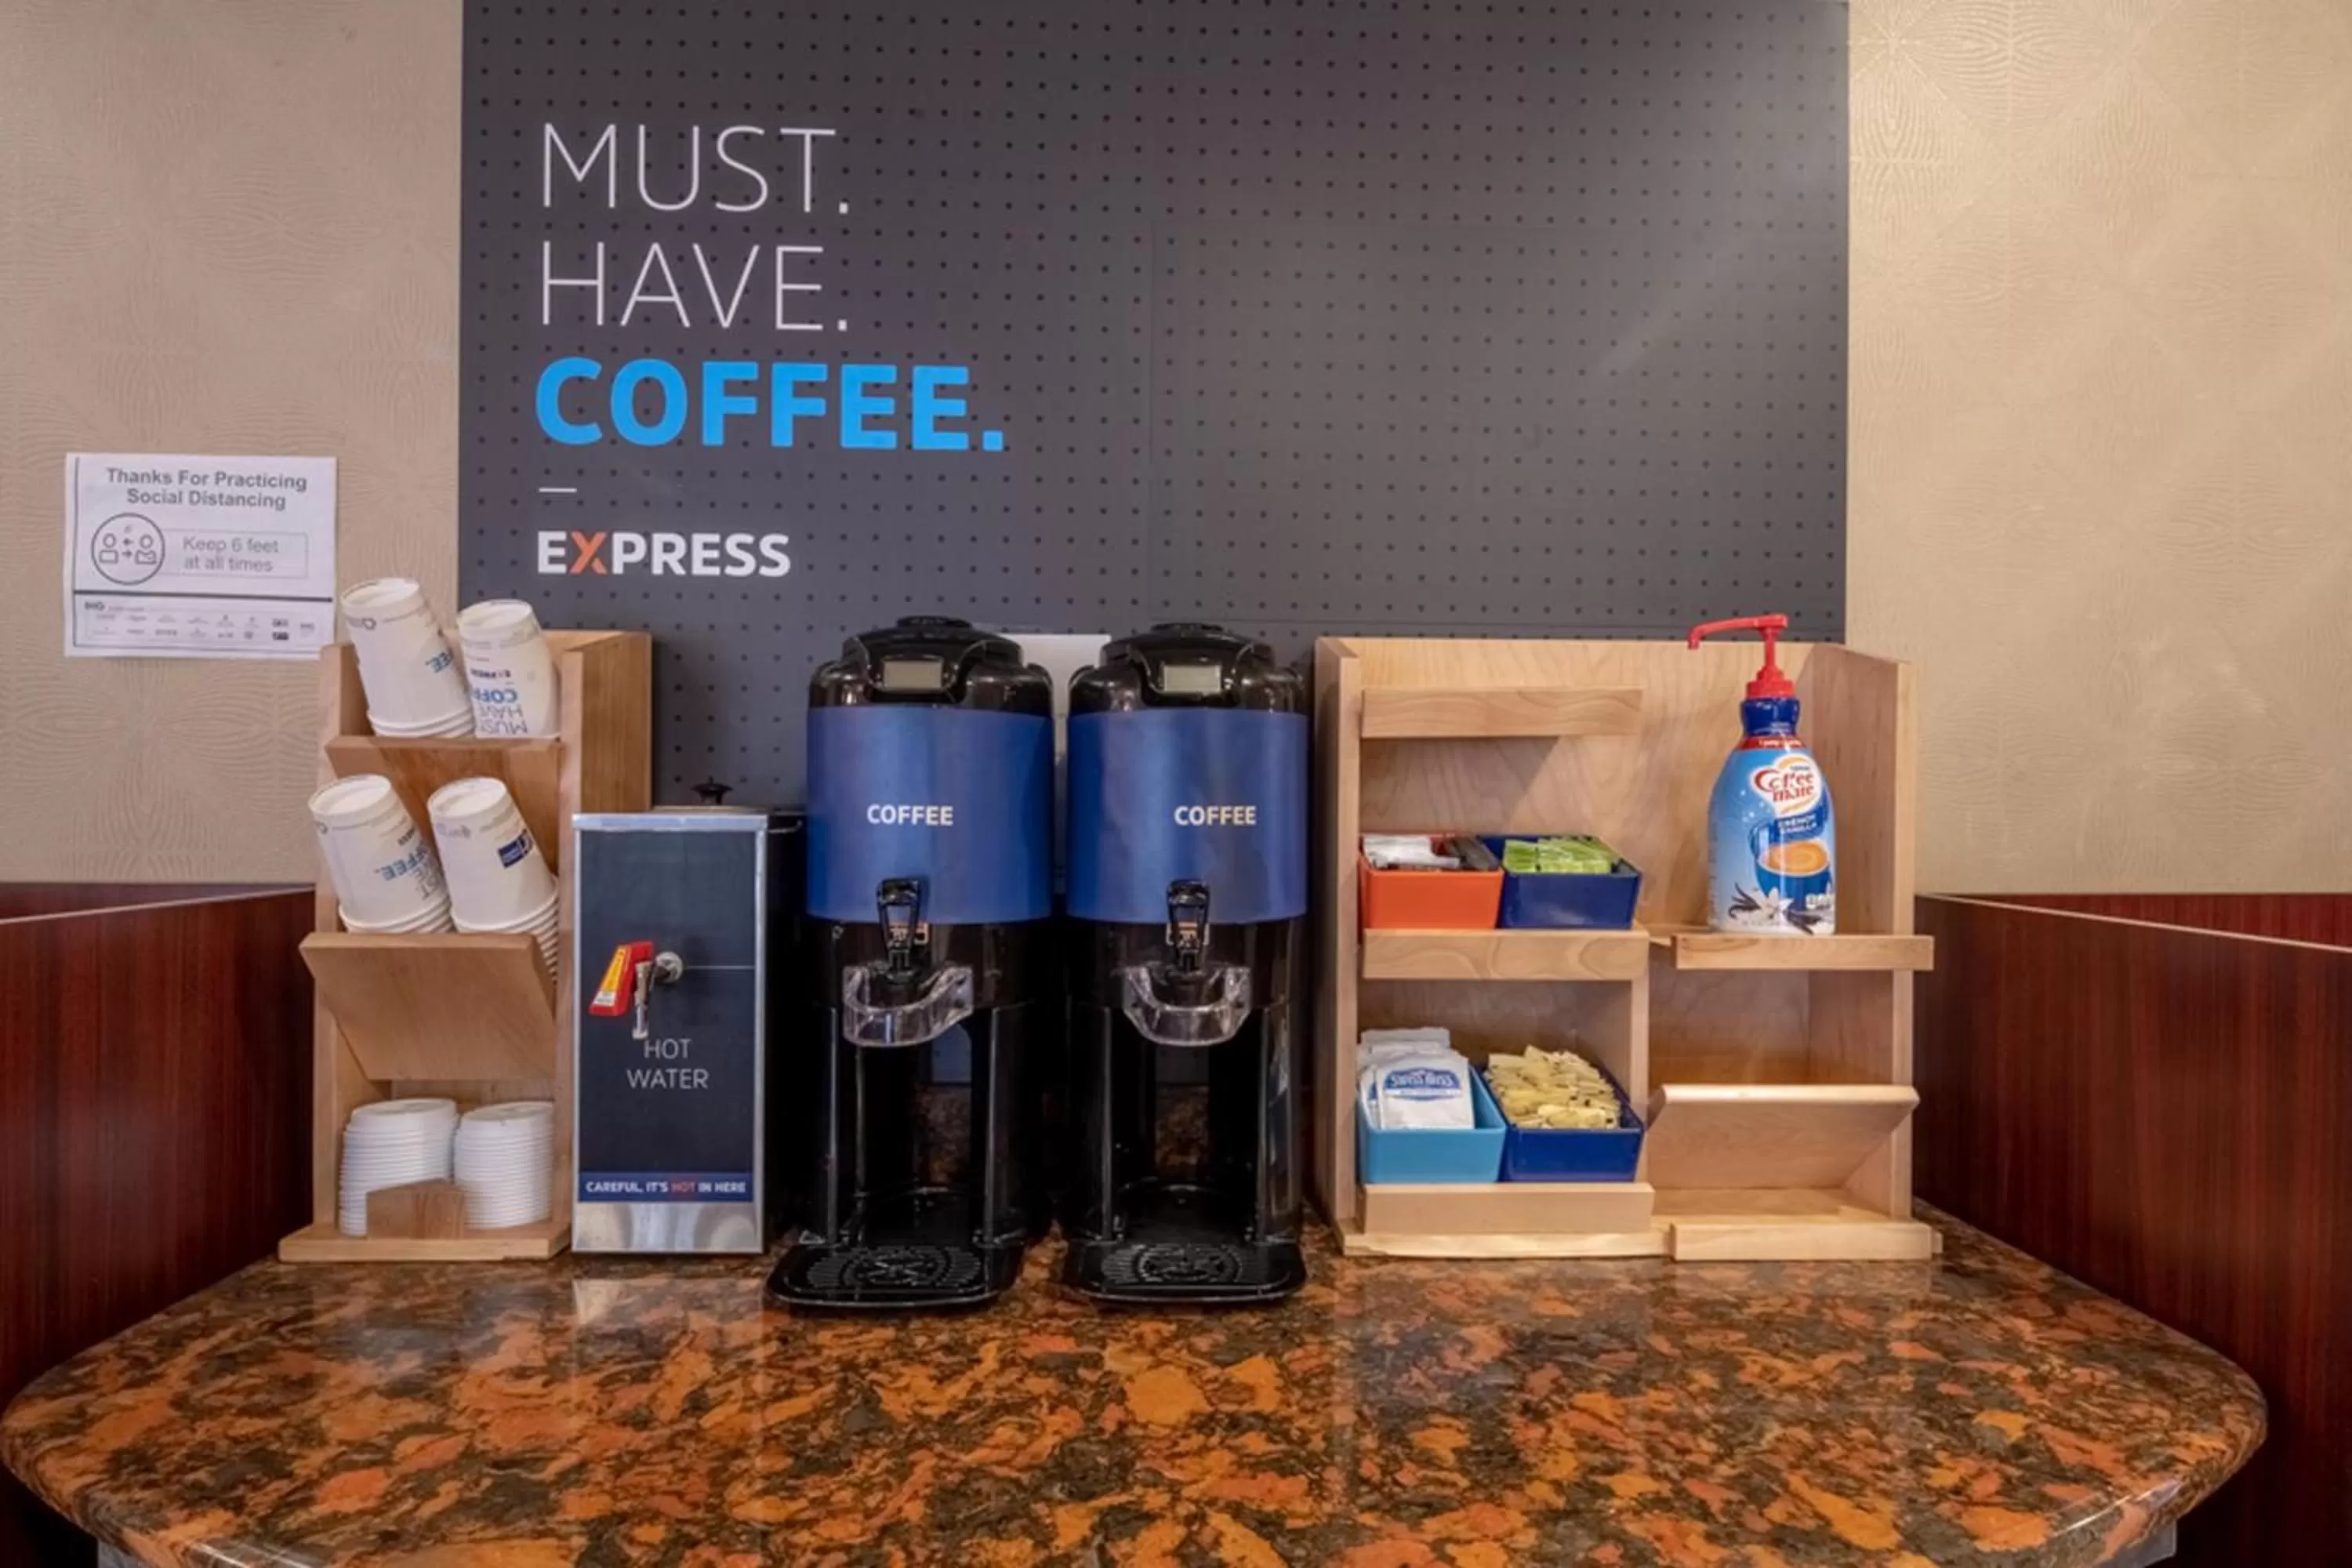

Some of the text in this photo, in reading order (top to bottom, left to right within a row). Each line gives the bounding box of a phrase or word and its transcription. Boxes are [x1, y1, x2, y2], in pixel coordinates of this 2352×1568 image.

[543, 122, 848, 214] MUST.
[543, 241, 848, 332] HAVE.
[535, 356, 1004, 452] COFFEE.
[107, 467, 307, 492] Thanks For Practicing
[127, 487, 286, 511] Social Distancing
[182, 535, 279, 555] Keep 6 feet
[538, 529, 791, 577] EXPRESS
[184, 555, 273, 572] at all times
[867, 804, 953, 826] COFFEE
[1174, 805, 1257, 826] COFFEE
[644, 1038, 691, 1059] HOT
[626, 1068, 710, 1090] WATER
[586, 1181, 746, 1193] CAREFUL, IT'S HOT IN HERE
